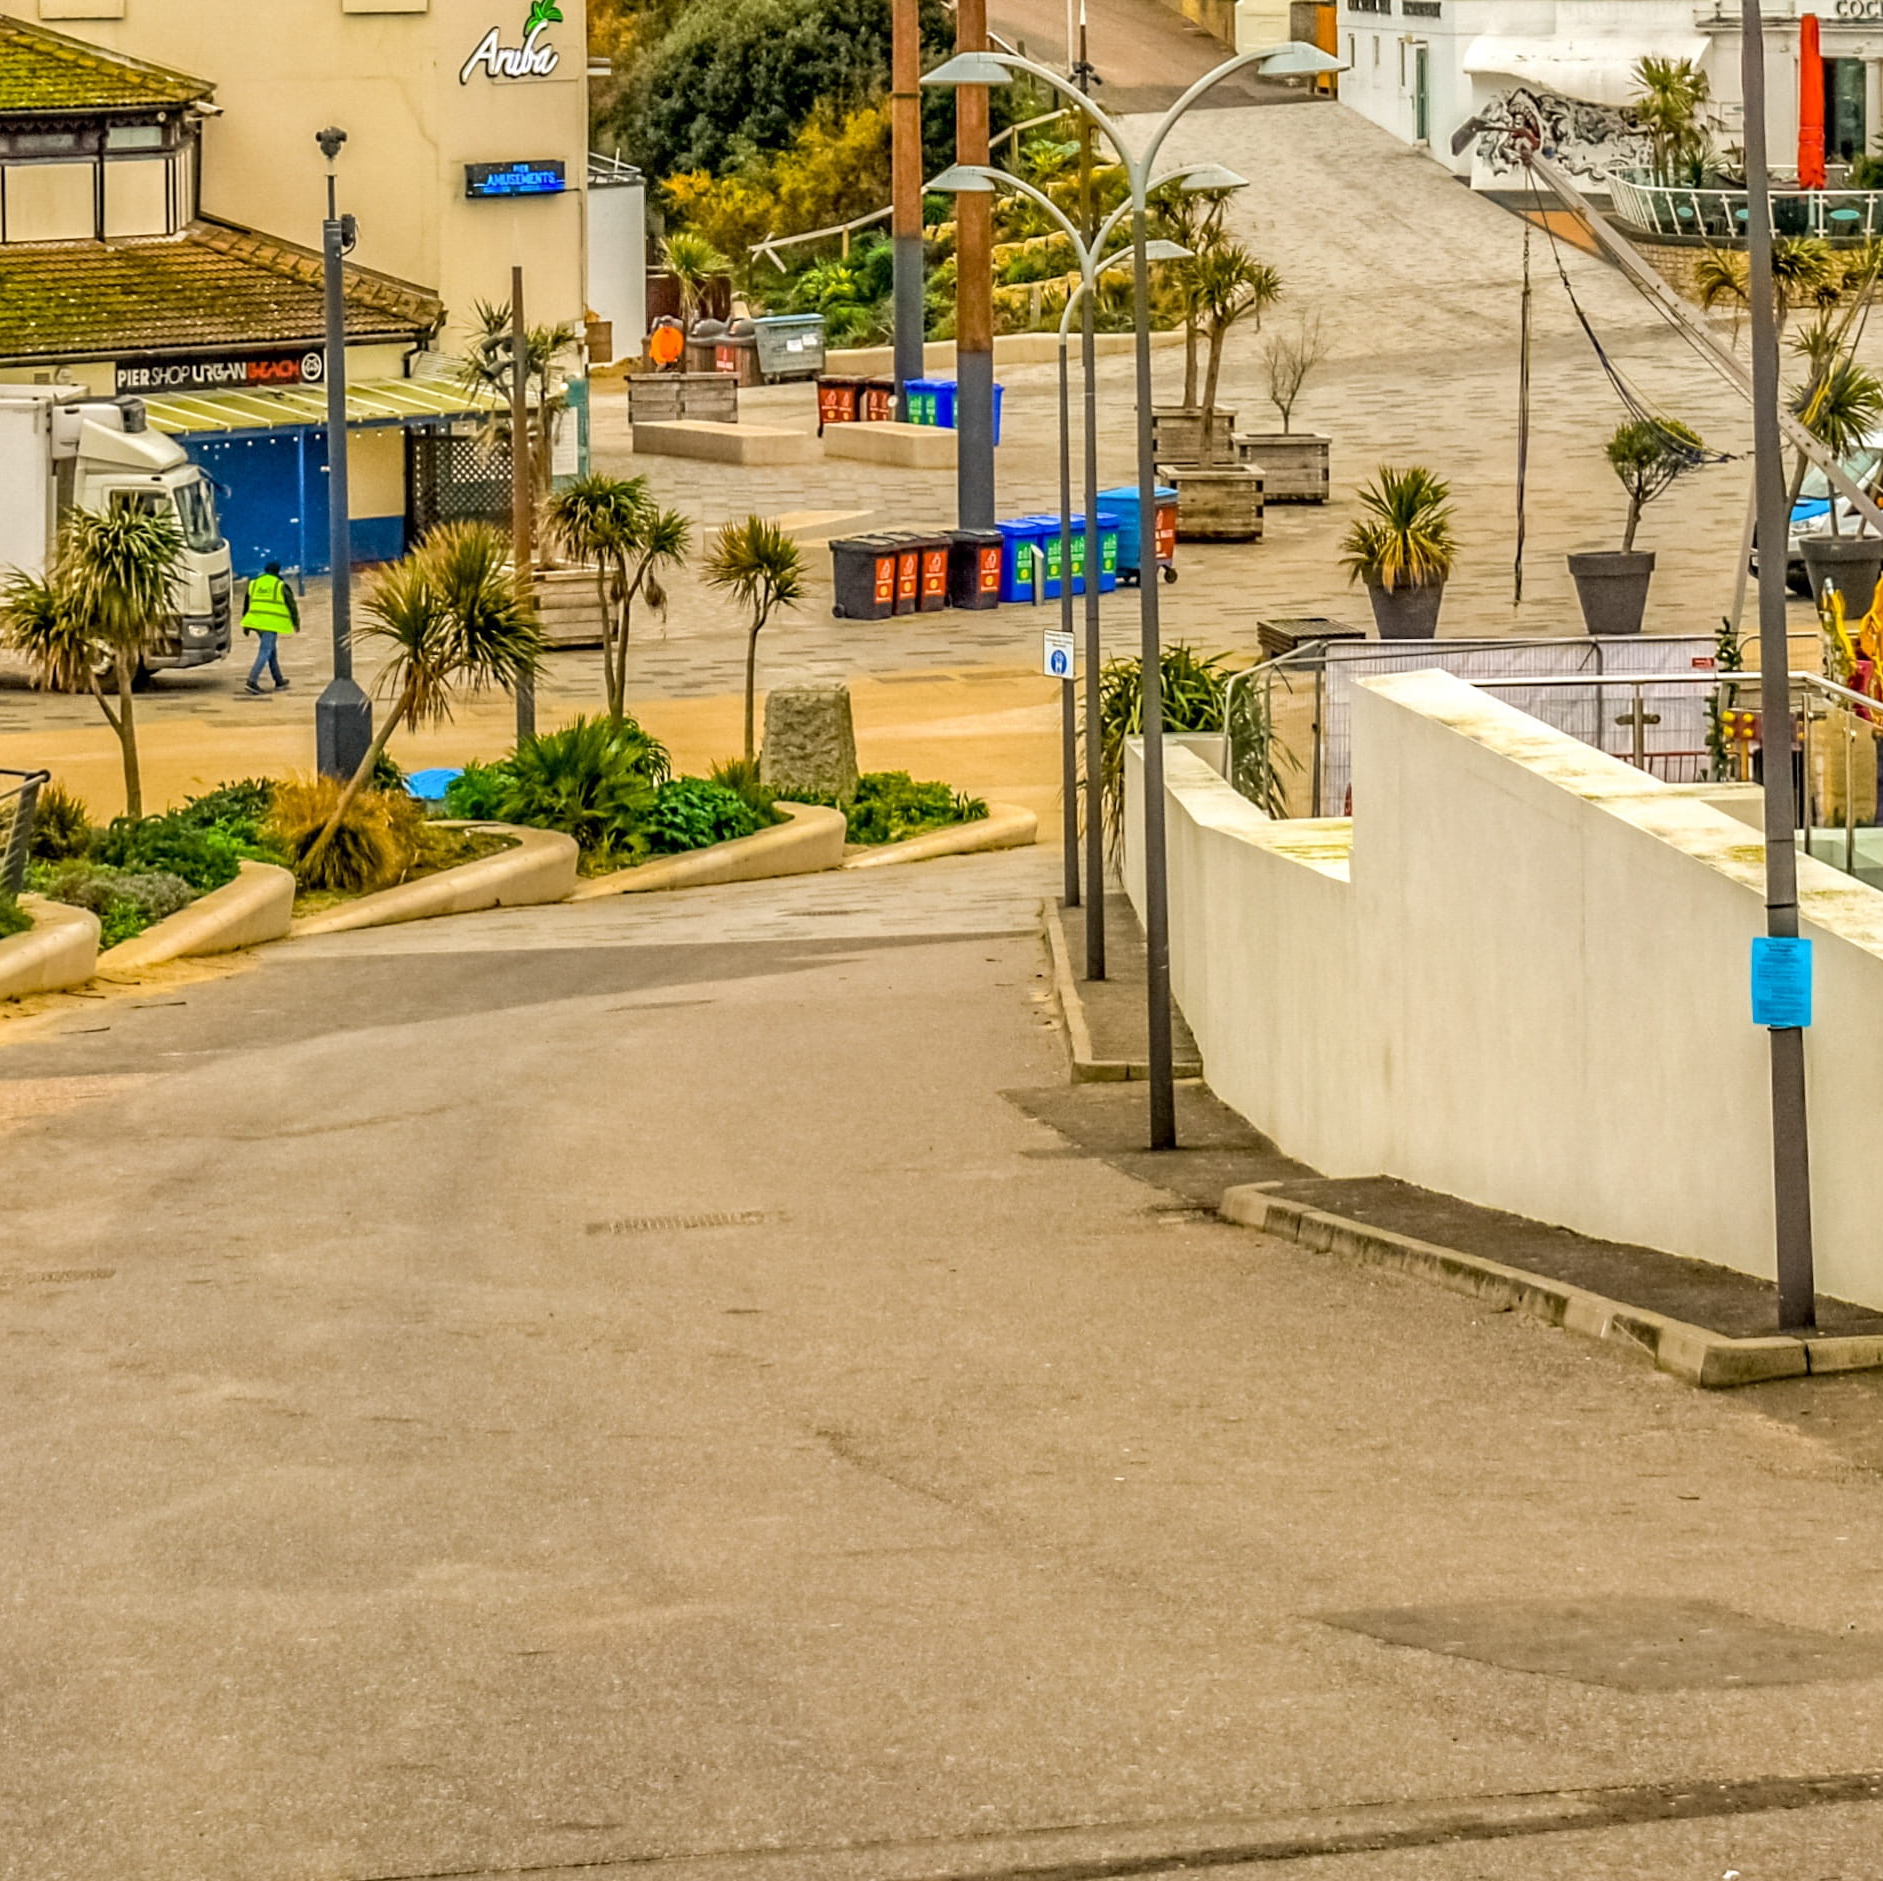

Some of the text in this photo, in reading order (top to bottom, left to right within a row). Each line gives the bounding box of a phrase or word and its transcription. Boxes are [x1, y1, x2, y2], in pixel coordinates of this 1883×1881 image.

[460, 19, 559, 84] Aruba
[487, 172, 556, 187] AMUSEMENTS
[118, 369, 150, 388] PIER
[150, 366, 190, 385] SHOP
[247, 359, 299, 378] BEACH
